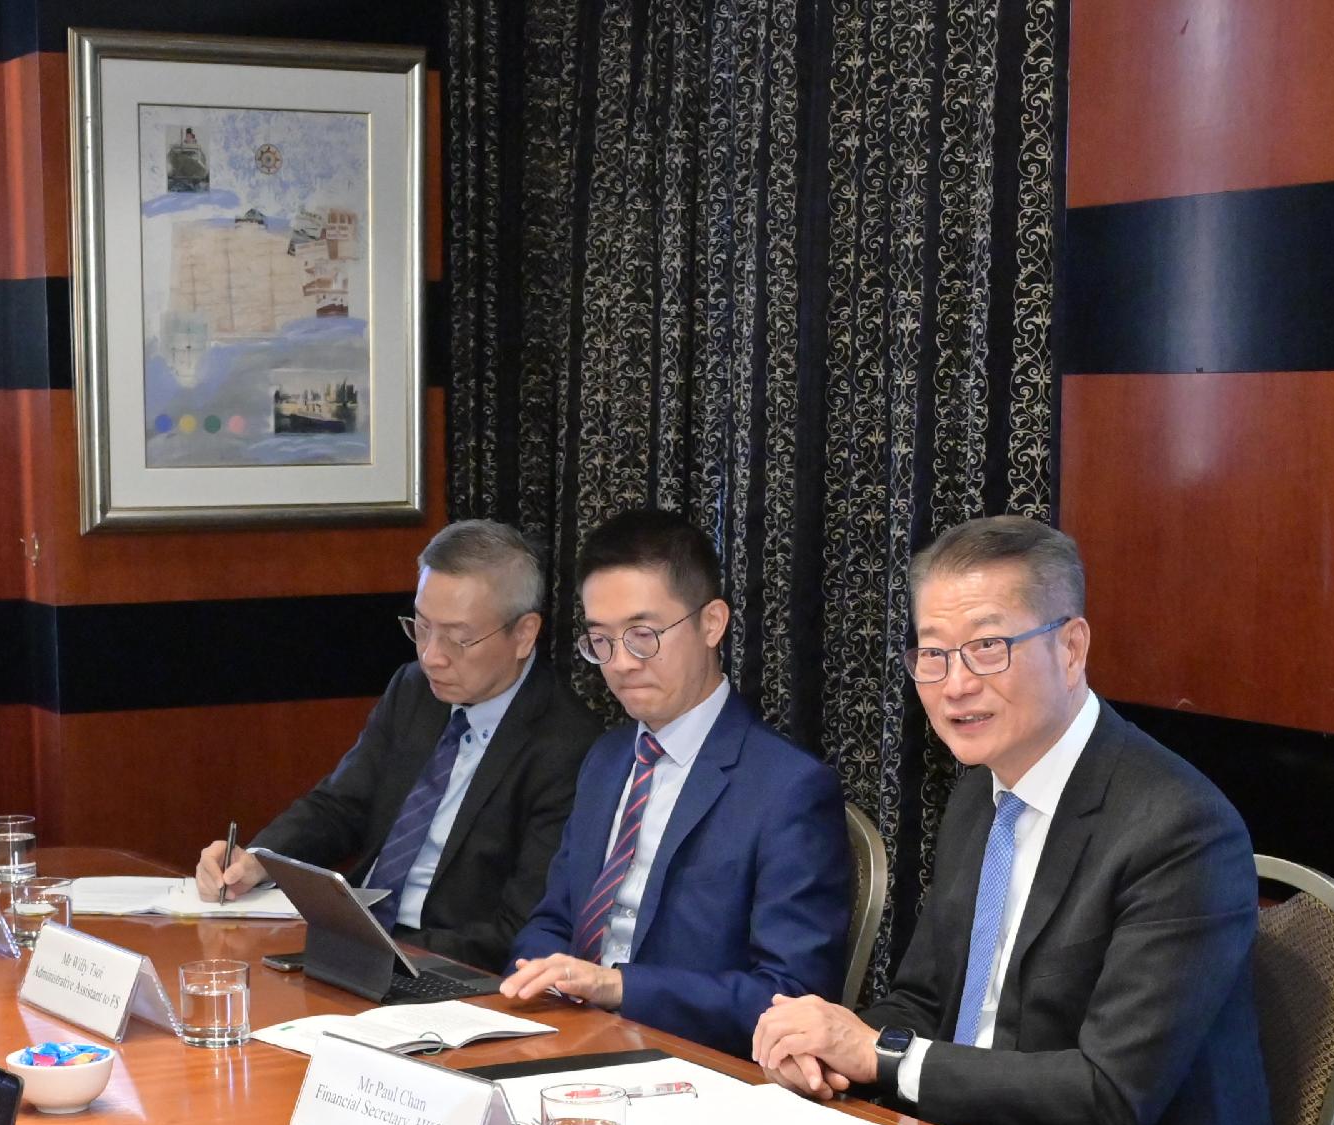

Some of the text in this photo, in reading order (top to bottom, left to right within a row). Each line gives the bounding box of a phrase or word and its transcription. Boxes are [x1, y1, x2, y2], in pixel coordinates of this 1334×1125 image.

[61, 952, 105, 979] Mr Willy Tsoi
[35, 964, 121, 1010] Administrative Assistant to FS
[315, 1083, 360, 1111] Financial
[356, 1075, 427, 1113] Mr Paul Chan
